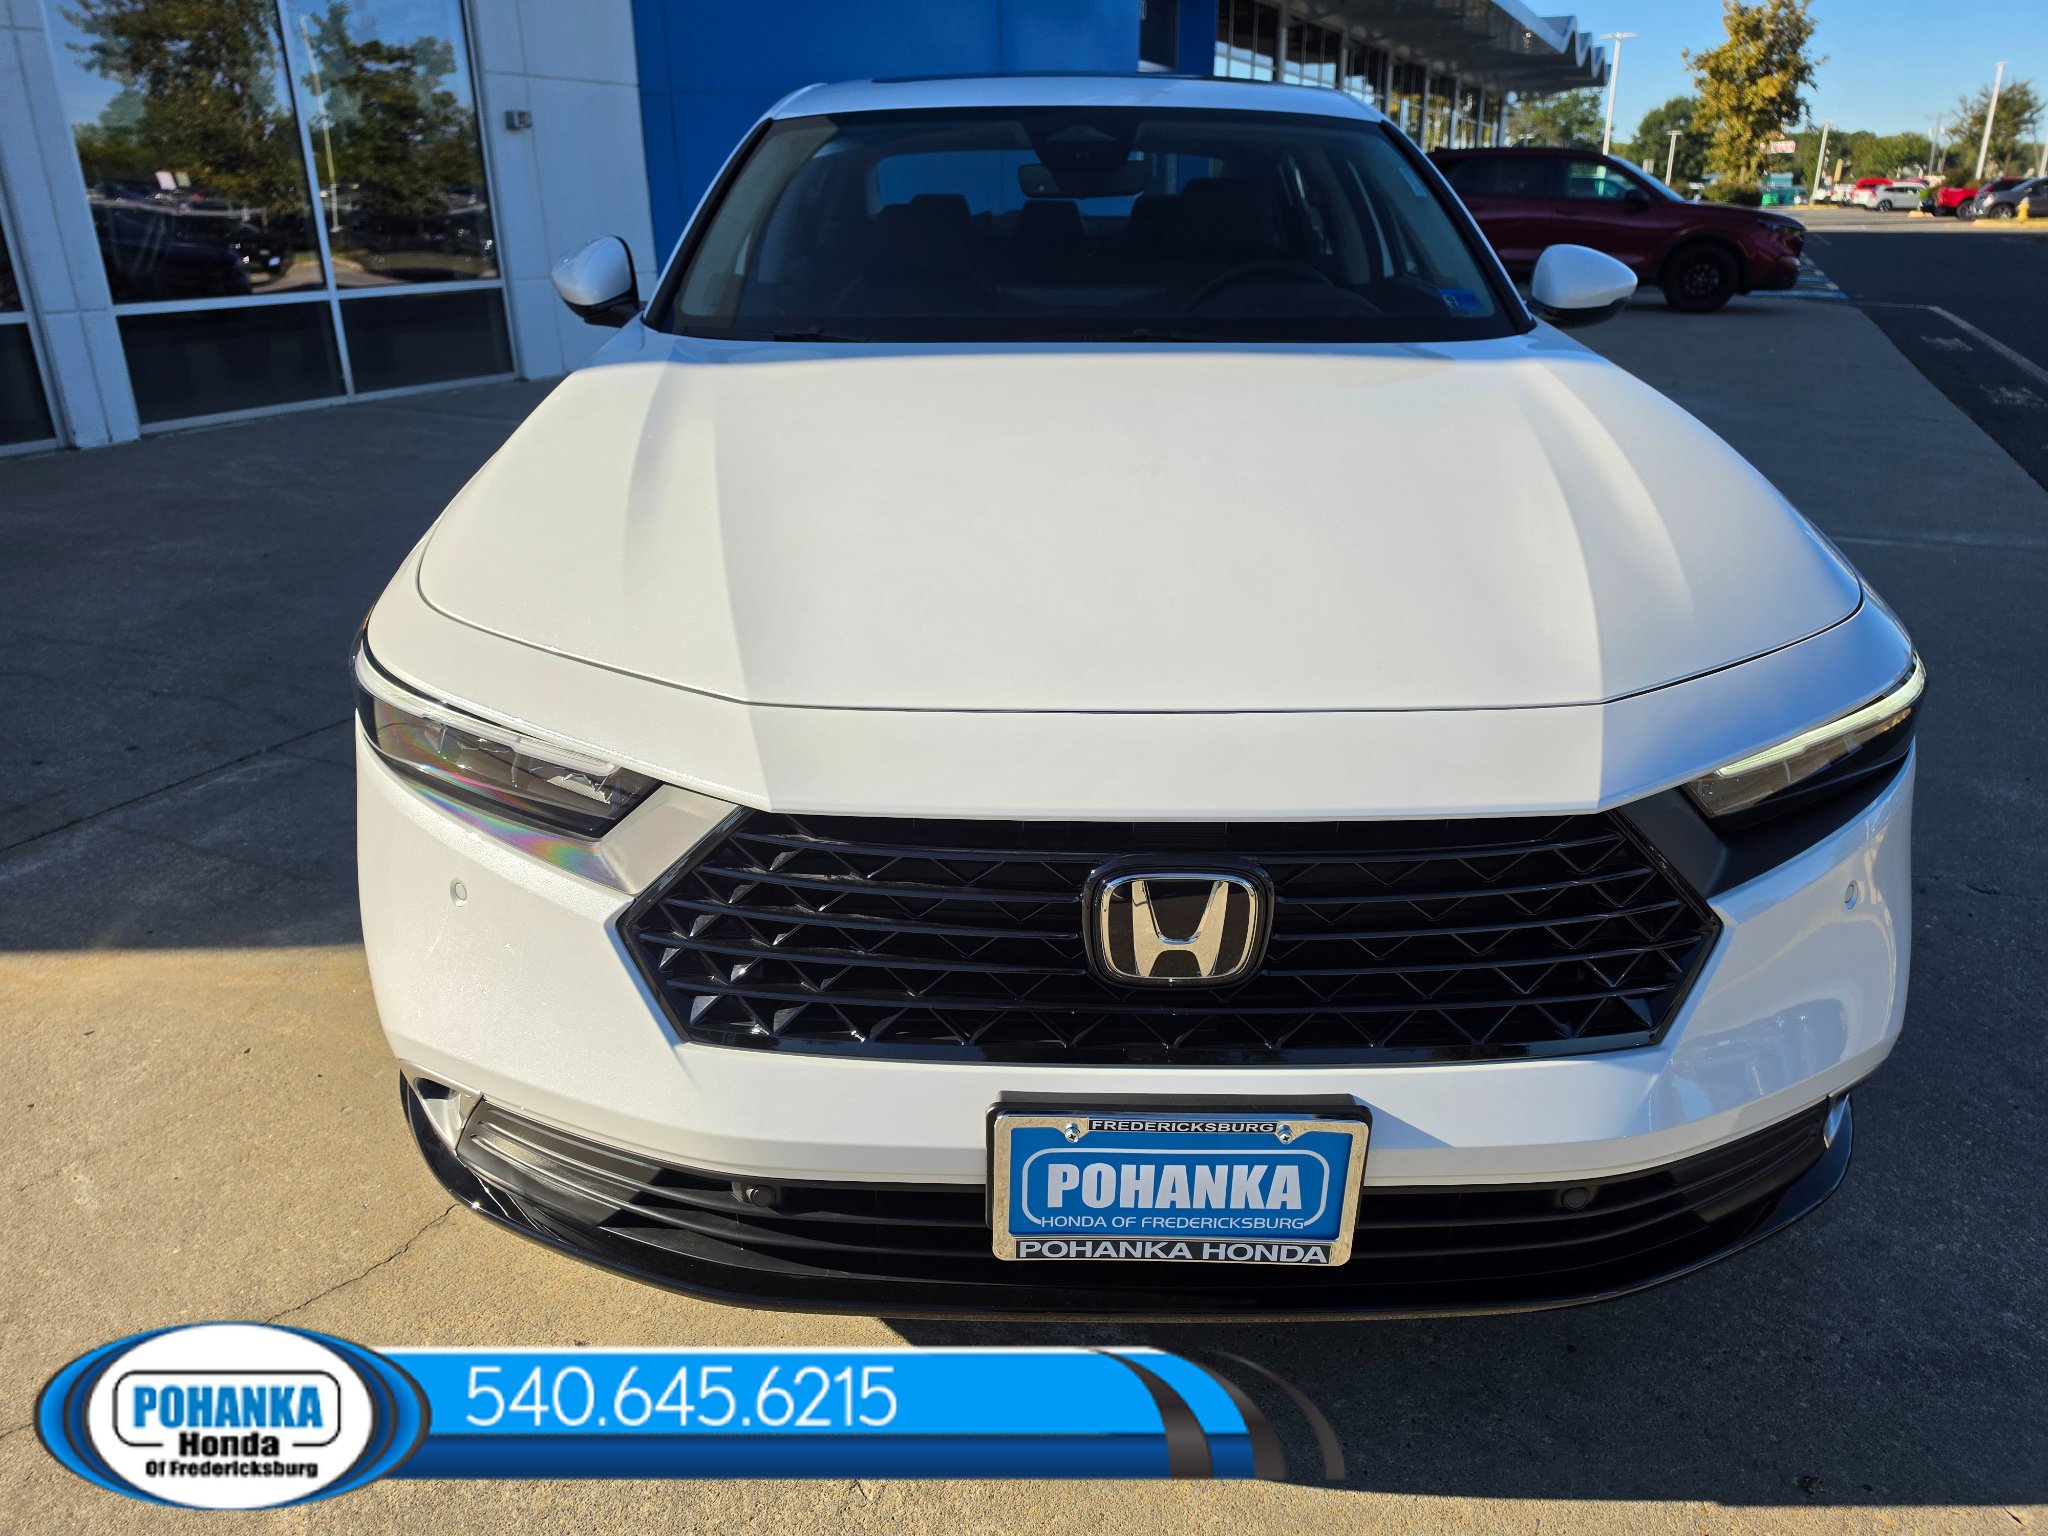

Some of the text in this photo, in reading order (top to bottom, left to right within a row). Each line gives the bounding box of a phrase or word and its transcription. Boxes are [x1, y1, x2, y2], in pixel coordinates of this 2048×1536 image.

[1092, 1120, 1275, 1133] FREDERICKSBURG
[1047, 1162, 1303, 1210] POHANKA
[1041, 1216, 1305, 1230] HONDA OF FREDERICKSBURG
[1019, 1240, 1328, 1263] POHANKA HONDA
